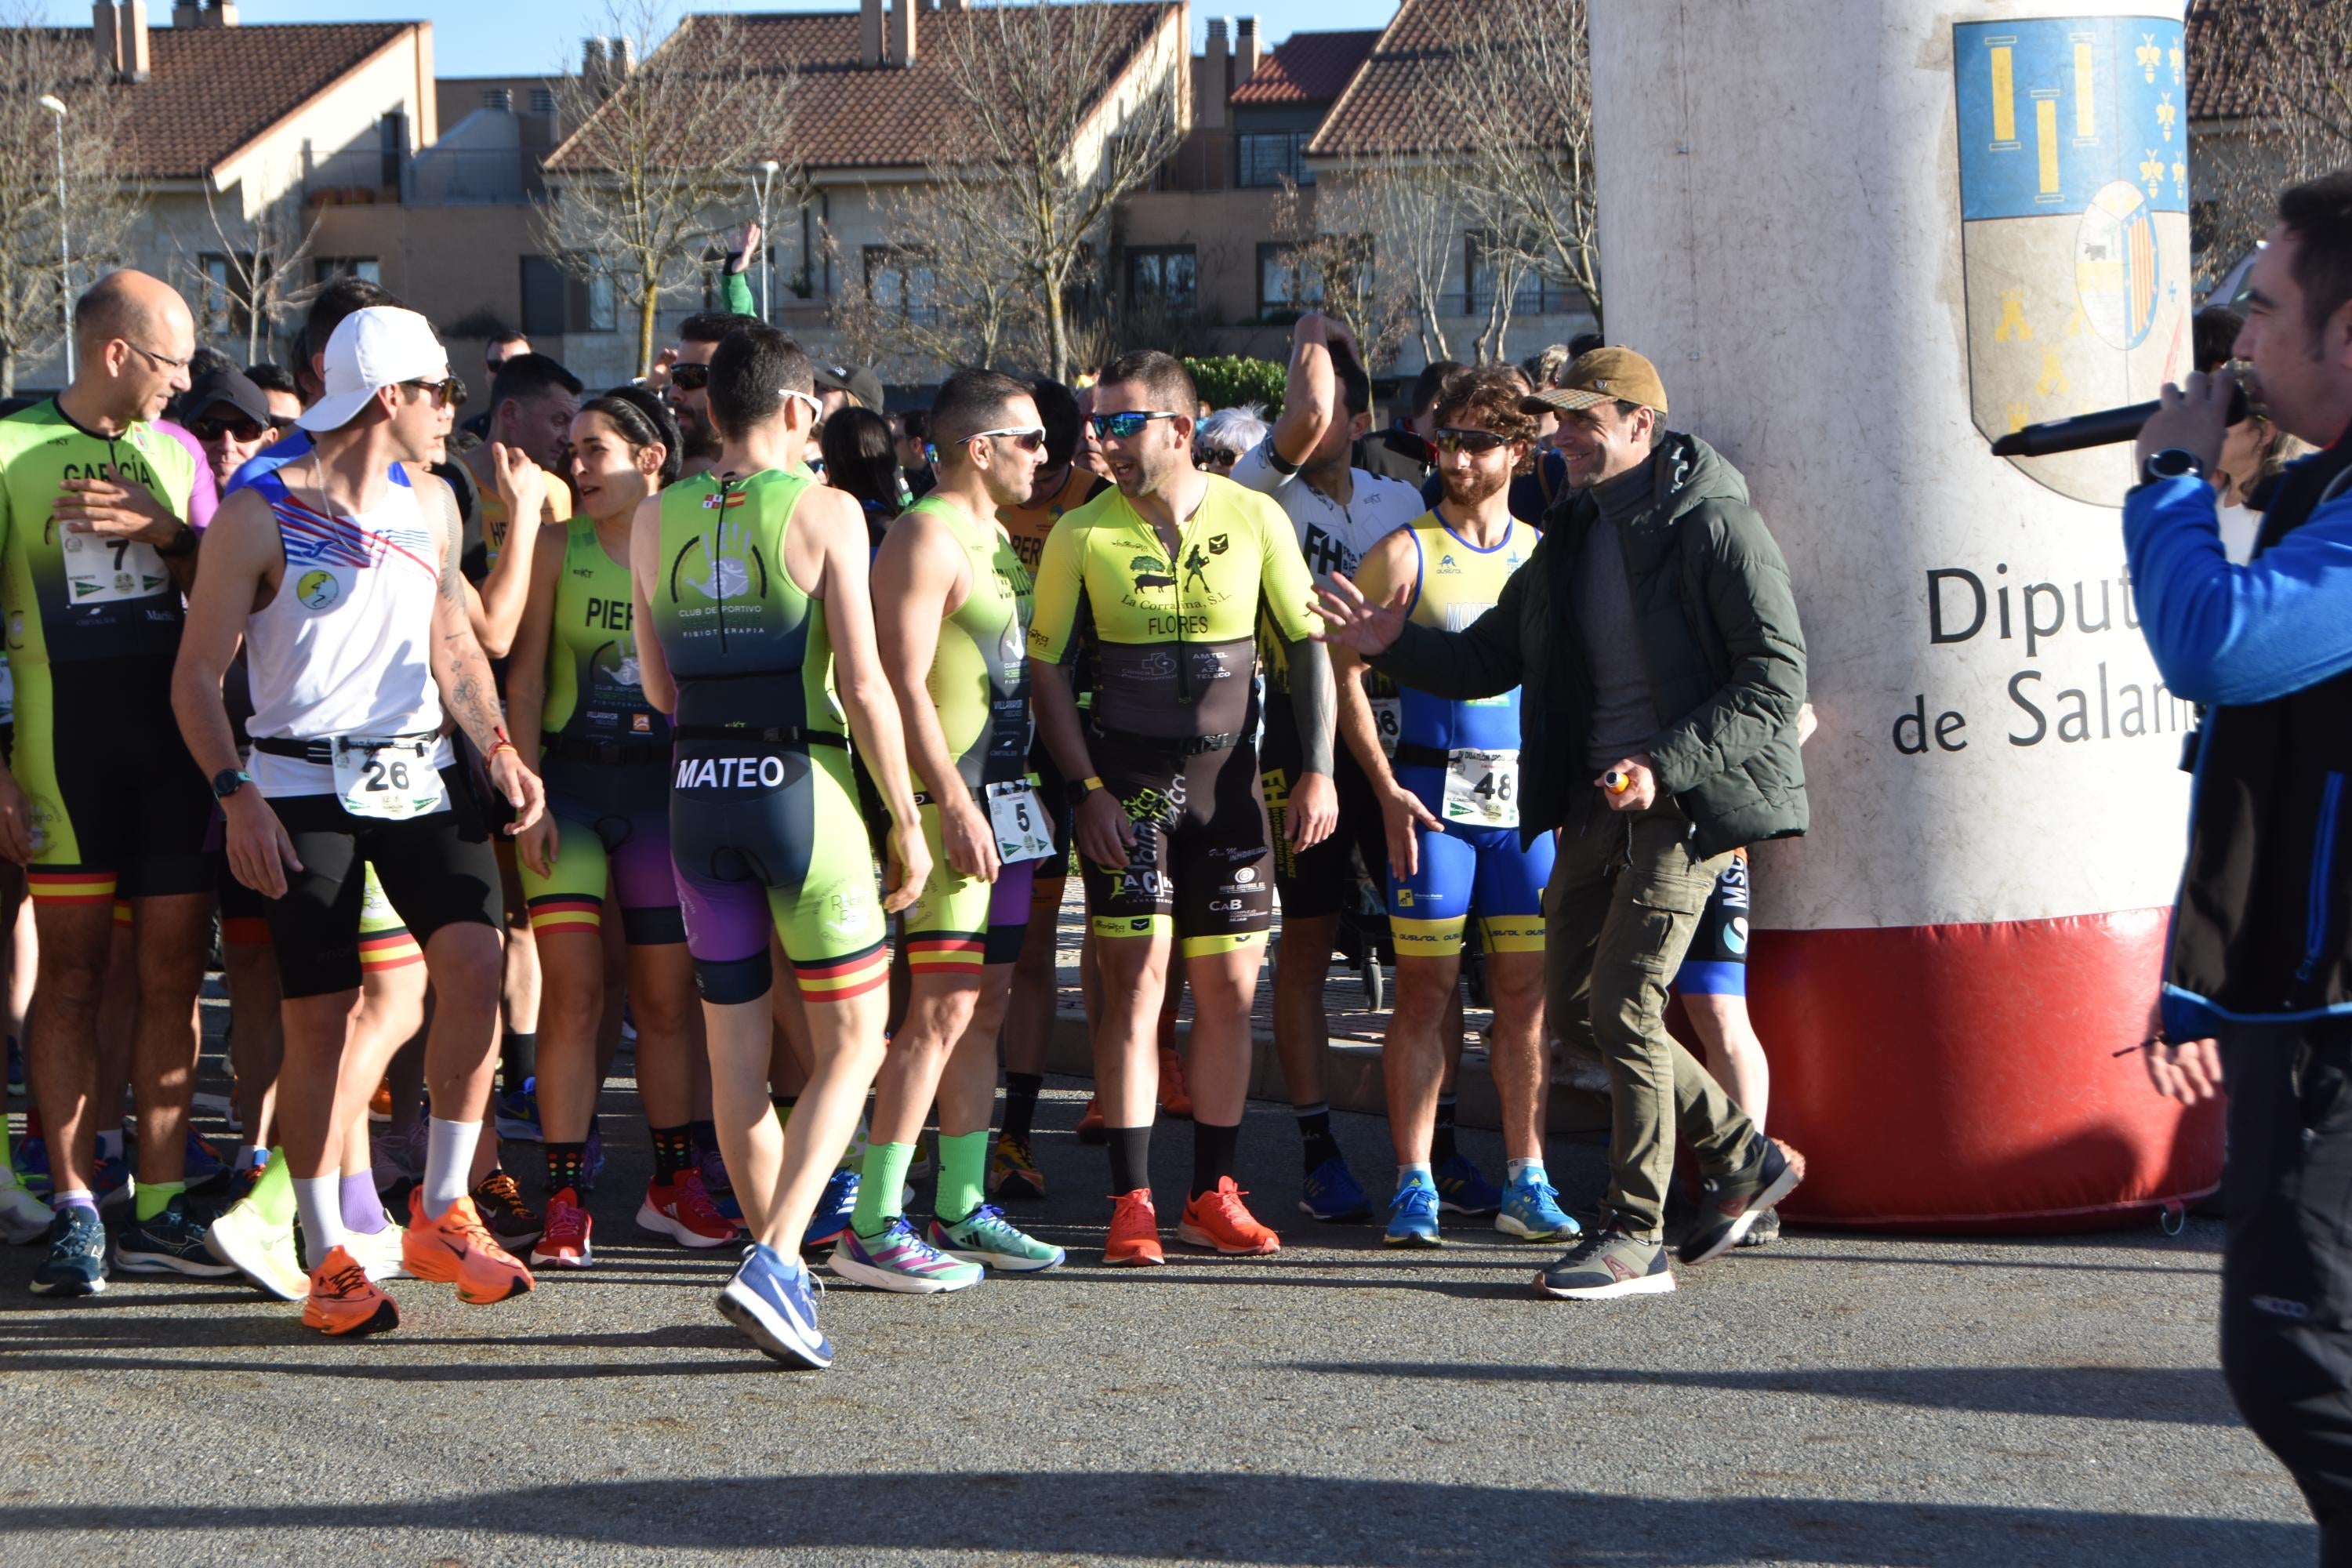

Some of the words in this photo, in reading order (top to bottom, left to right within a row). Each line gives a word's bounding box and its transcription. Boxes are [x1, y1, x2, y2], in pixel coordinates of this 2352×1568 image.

[106, 539, 129, 571] 7
[1121, 594, 1137, 607] La
[1926, 562, 2142, 657] Diput
[1149, 615, 1208, 635] FLORES
[1892, 694, 1968, 755] de
[2008, 661, 2194, 747] Salam
[361, 760, 409, 792] 26
[675, 757, 784, 789] MATEO
[1474, 771, 1512, 800] 48
[1015, 802, 1030, 833] 5
